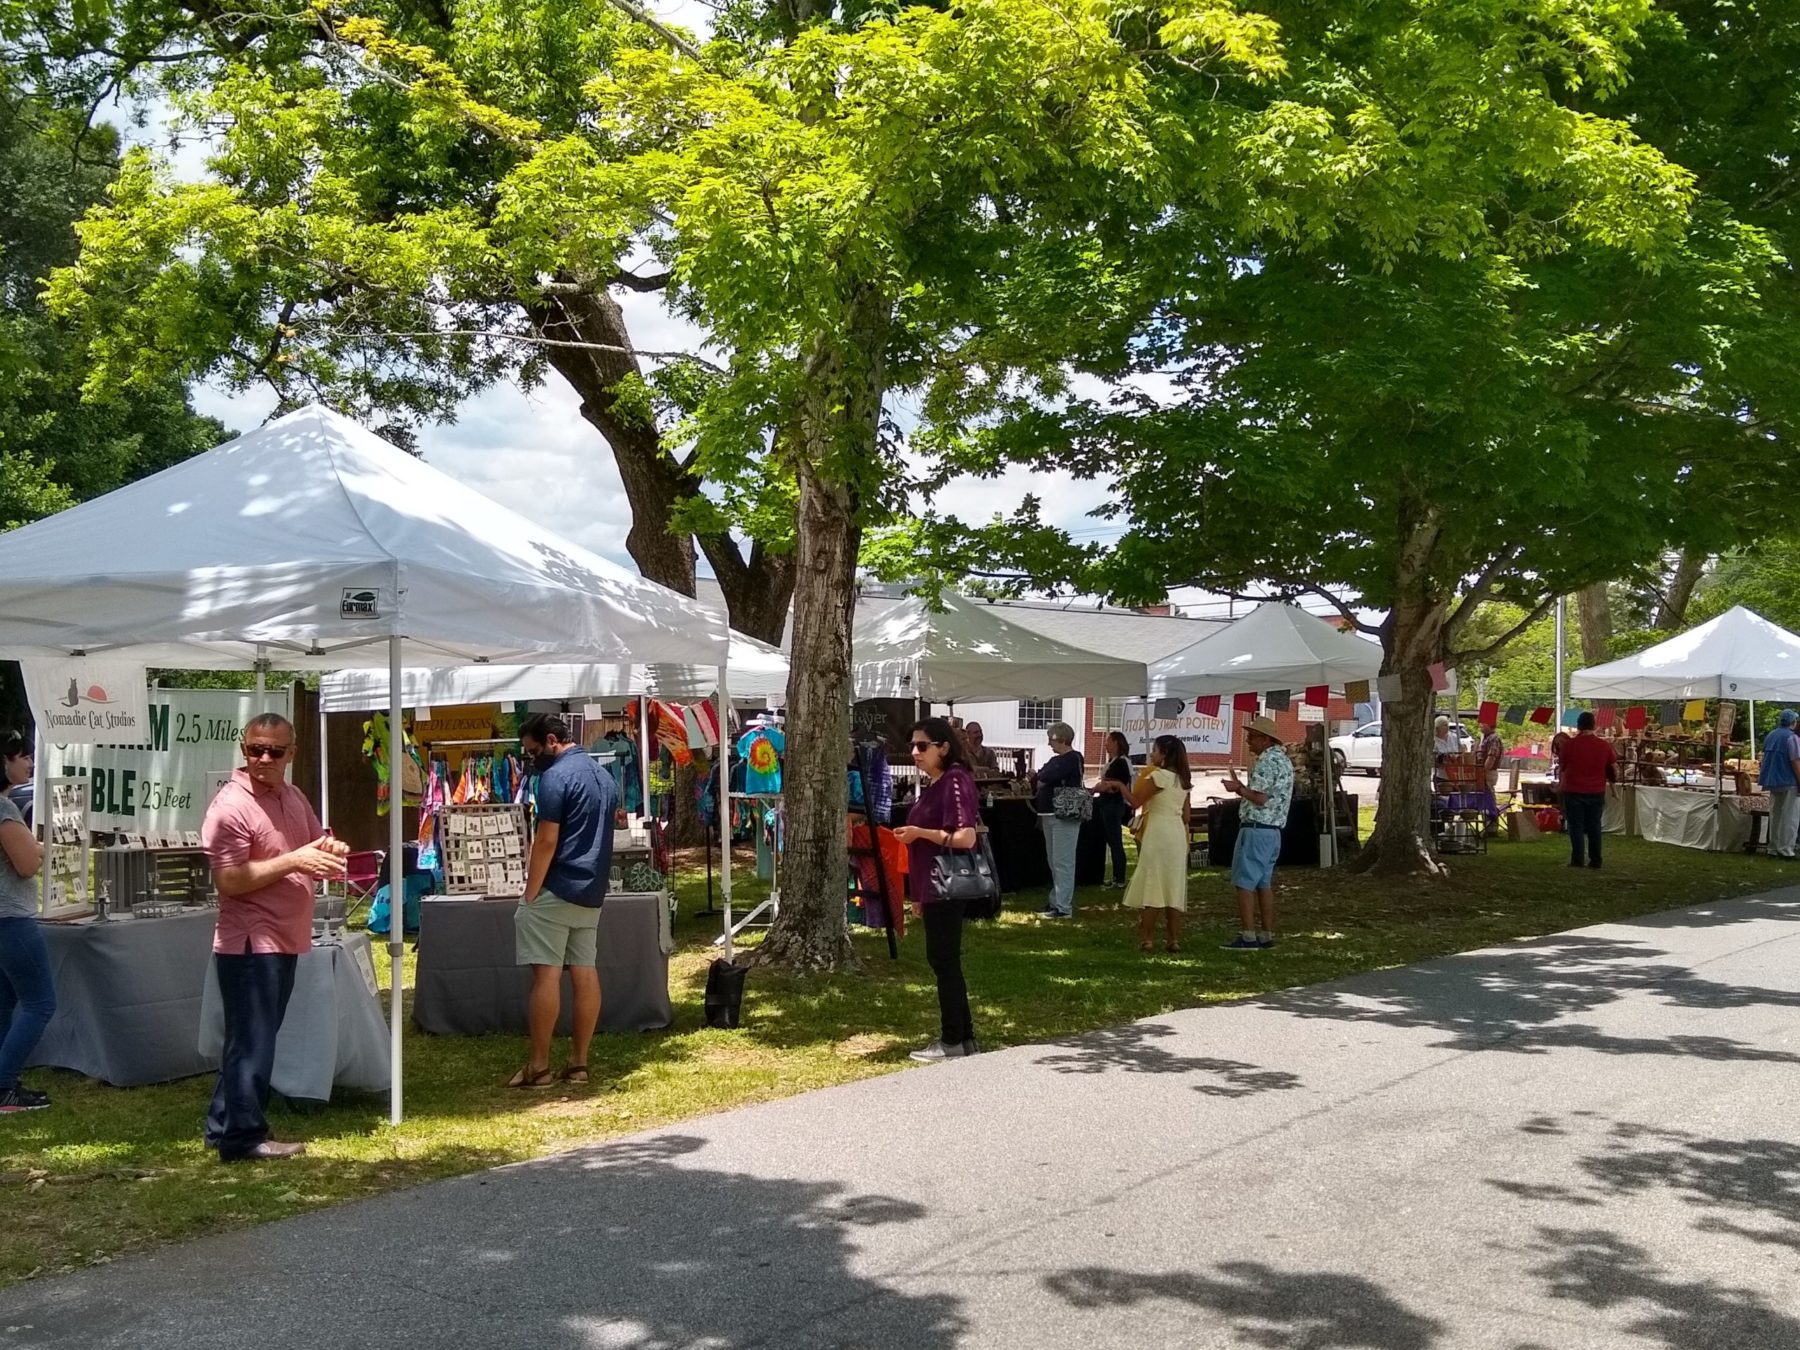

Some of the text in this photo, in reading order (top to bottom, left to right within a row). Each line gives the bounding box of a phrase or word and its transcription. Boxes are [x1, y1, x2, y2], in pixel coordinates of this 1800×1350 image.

[45, 709, 136, 730] Nomadic Cat Studios
[176, 713, 201, 743] 2.5
[205, 719, 245, 742] Miles
[1125, 719, 1157, 732] STUDO
[1186, 717, 1226, 731] POTTERY
[63, 765, 192, 816] BLE 25 Feet
